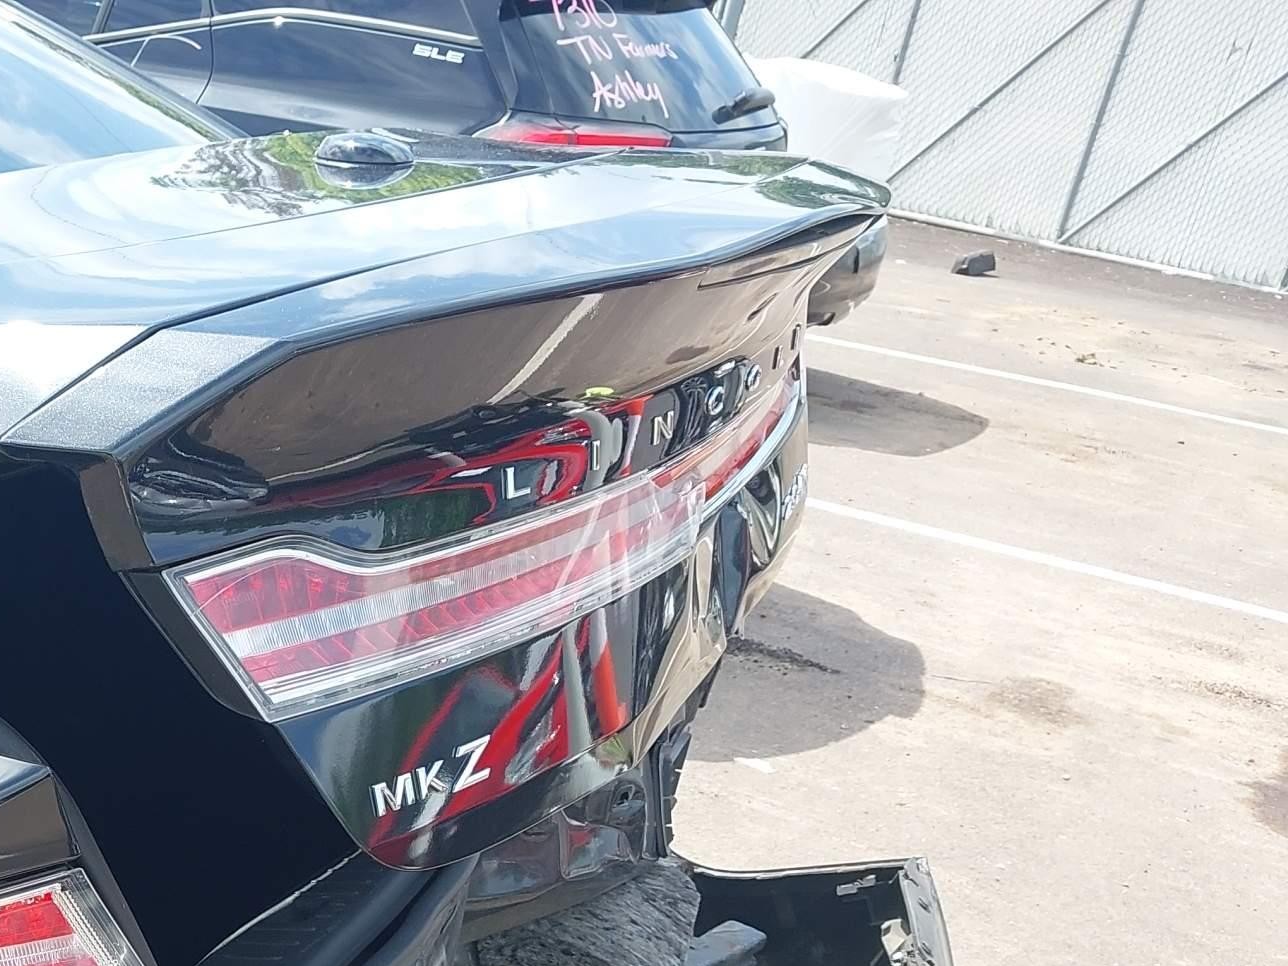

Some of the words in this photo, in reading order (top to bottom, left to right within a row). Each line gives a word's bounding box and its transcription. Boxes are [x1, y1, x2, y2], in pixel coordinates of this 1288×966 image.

[412, 42, 465, 64] SLE
[556, 34, 613, 65] TN
[590, 69, 670, 119] Ashley
[368, 734, 492, 818] MKZ
